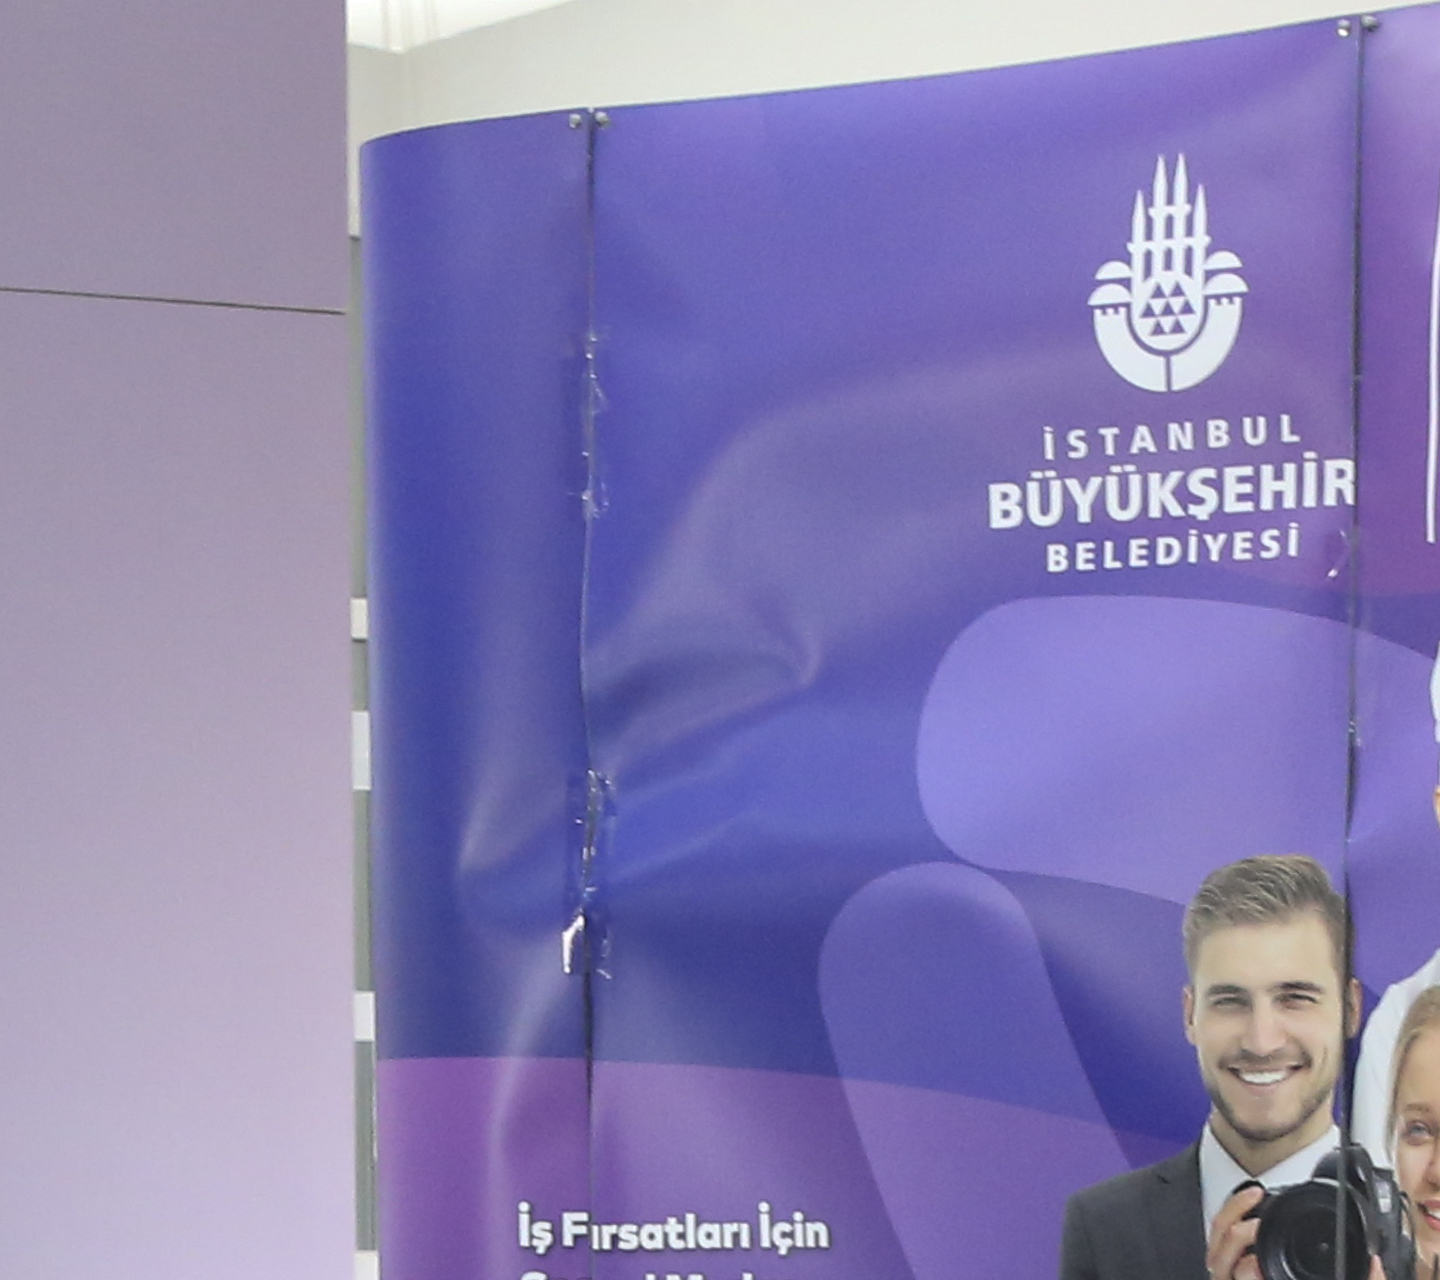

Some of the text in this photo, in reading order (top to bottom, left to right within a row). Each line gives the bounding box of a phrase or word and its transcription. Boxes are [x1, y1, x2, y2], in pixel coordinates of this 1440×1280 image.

[1042, 413, 1301, 461] İSTANBUL
[988, 451, 1356, 530] BÜYÜKŞEHİR
[1046, 522, 1300, 573] BELEDİYESİ
[517, 1200, 830, 1256] İş Fırsatları İçin
